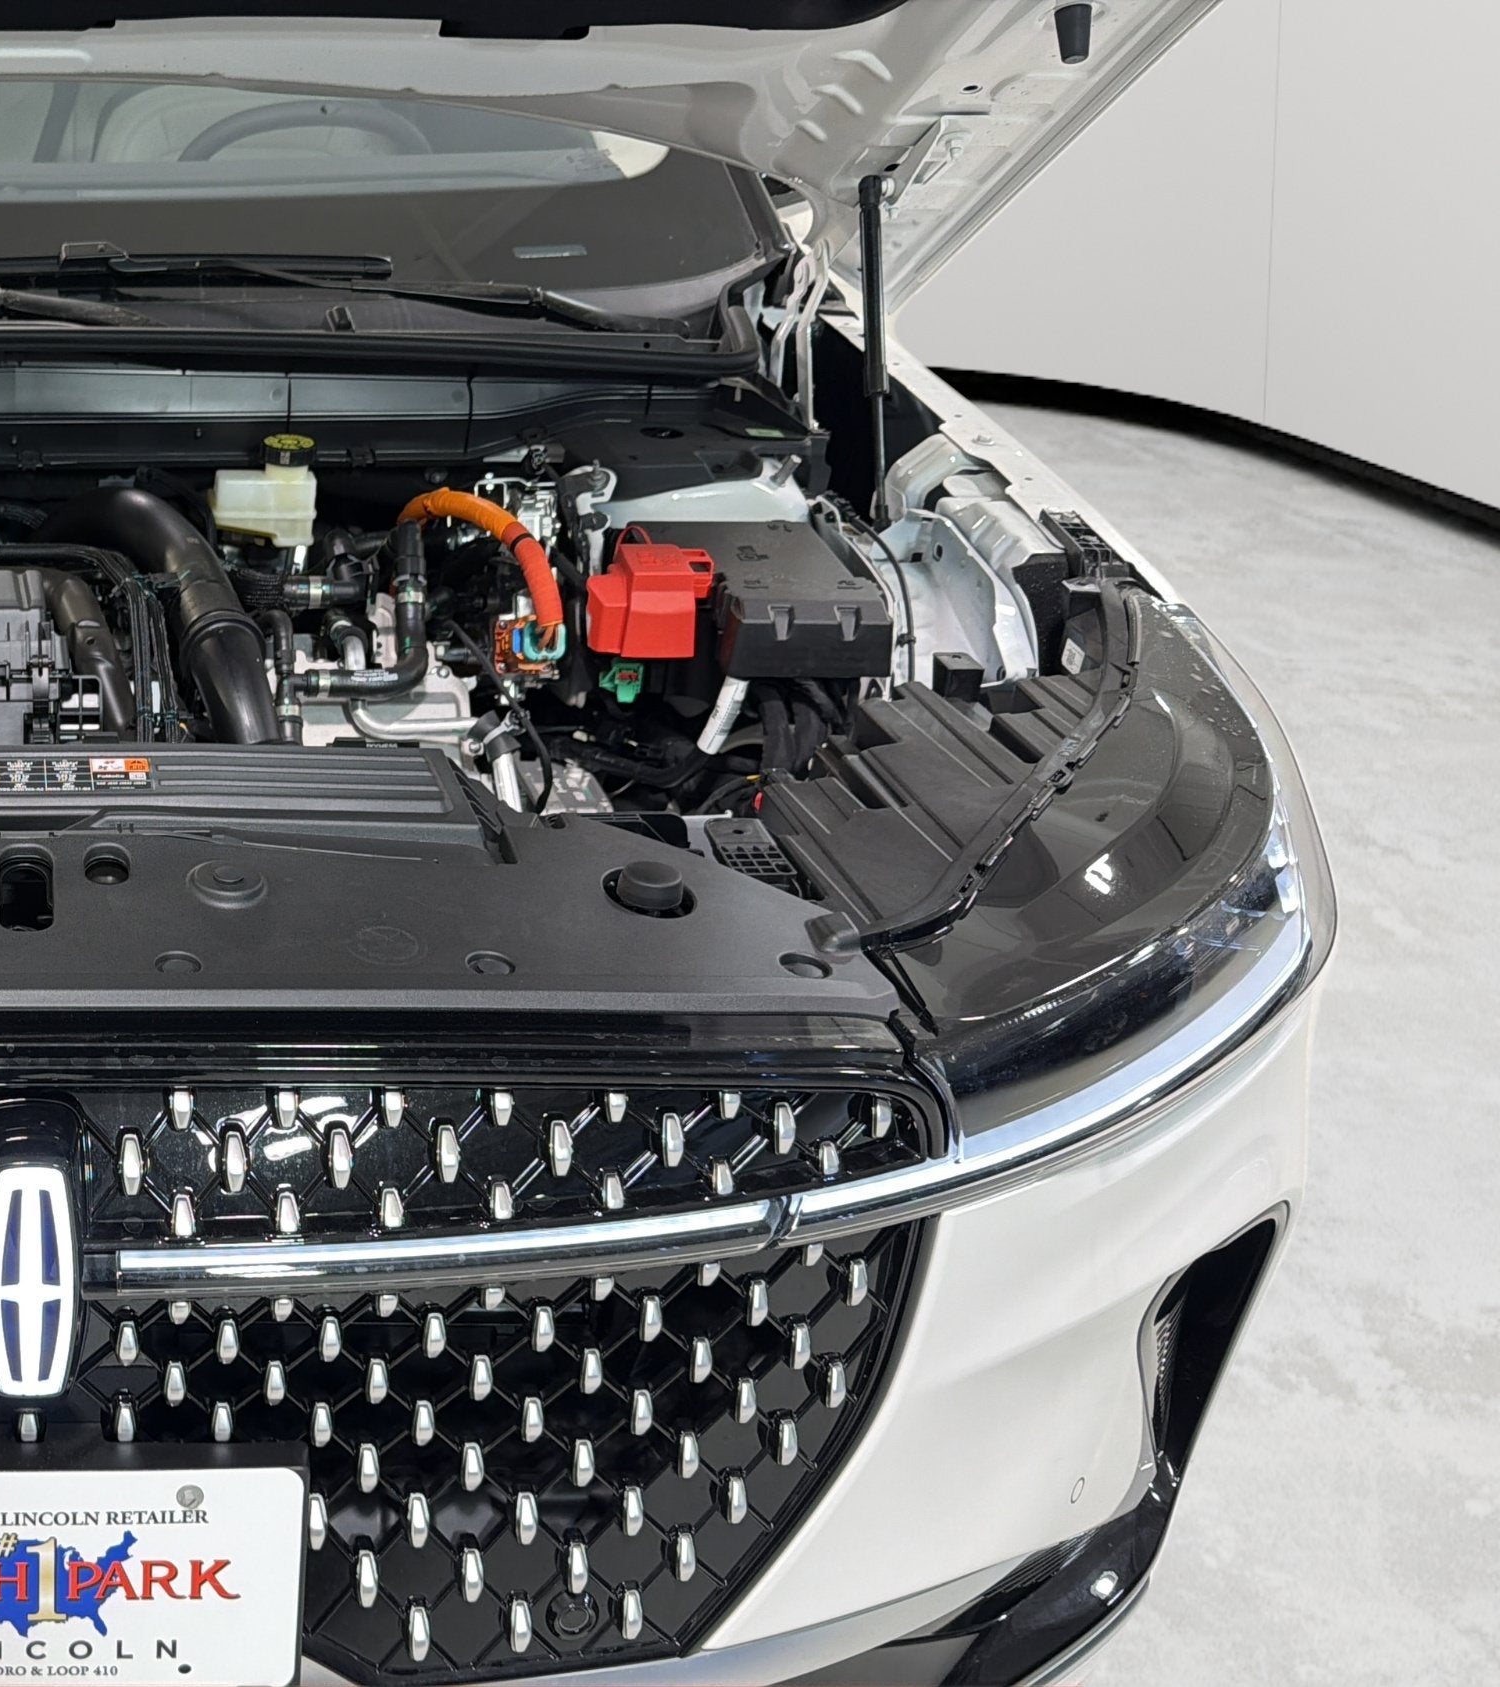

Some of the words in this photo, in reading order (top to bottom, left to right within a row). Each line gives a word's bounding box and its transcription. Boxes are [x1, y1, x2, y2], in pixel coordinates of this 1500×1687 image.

[0, 1511, 100, 1526] LINCOLN
[106, 1510, 209, 1525] RETAILER
[66, 1559, 242, 1600] PARK
[30, 1665, 44, 1676] &
[47, 1665, 90, 1676] LOOP
[93, 1665, 118, 1676] 410
